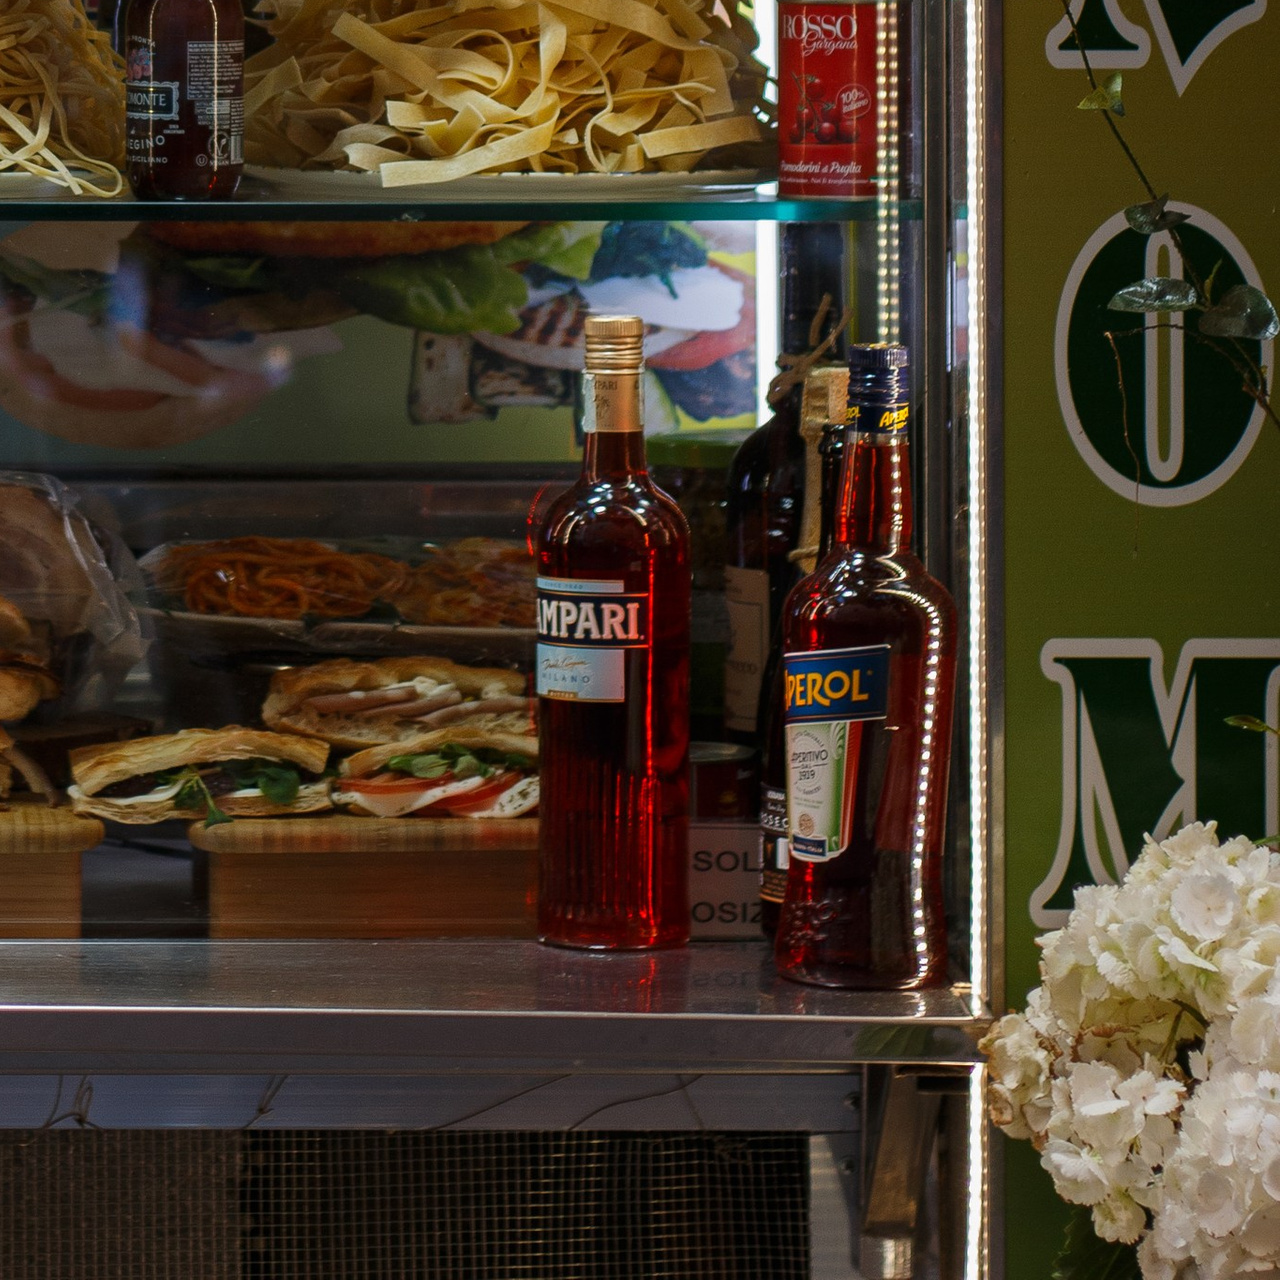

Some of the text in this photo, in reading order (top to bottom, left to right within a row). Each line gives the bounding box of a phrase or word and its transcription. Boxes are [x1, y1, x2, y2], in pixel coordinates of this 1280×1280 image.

[782, 14, 858, 41] ROSSO
[829, 160, 862, 178] Puglia
[791, 748, 829, 764] APERITIVO
[798, 769, 817, 782] 1919
